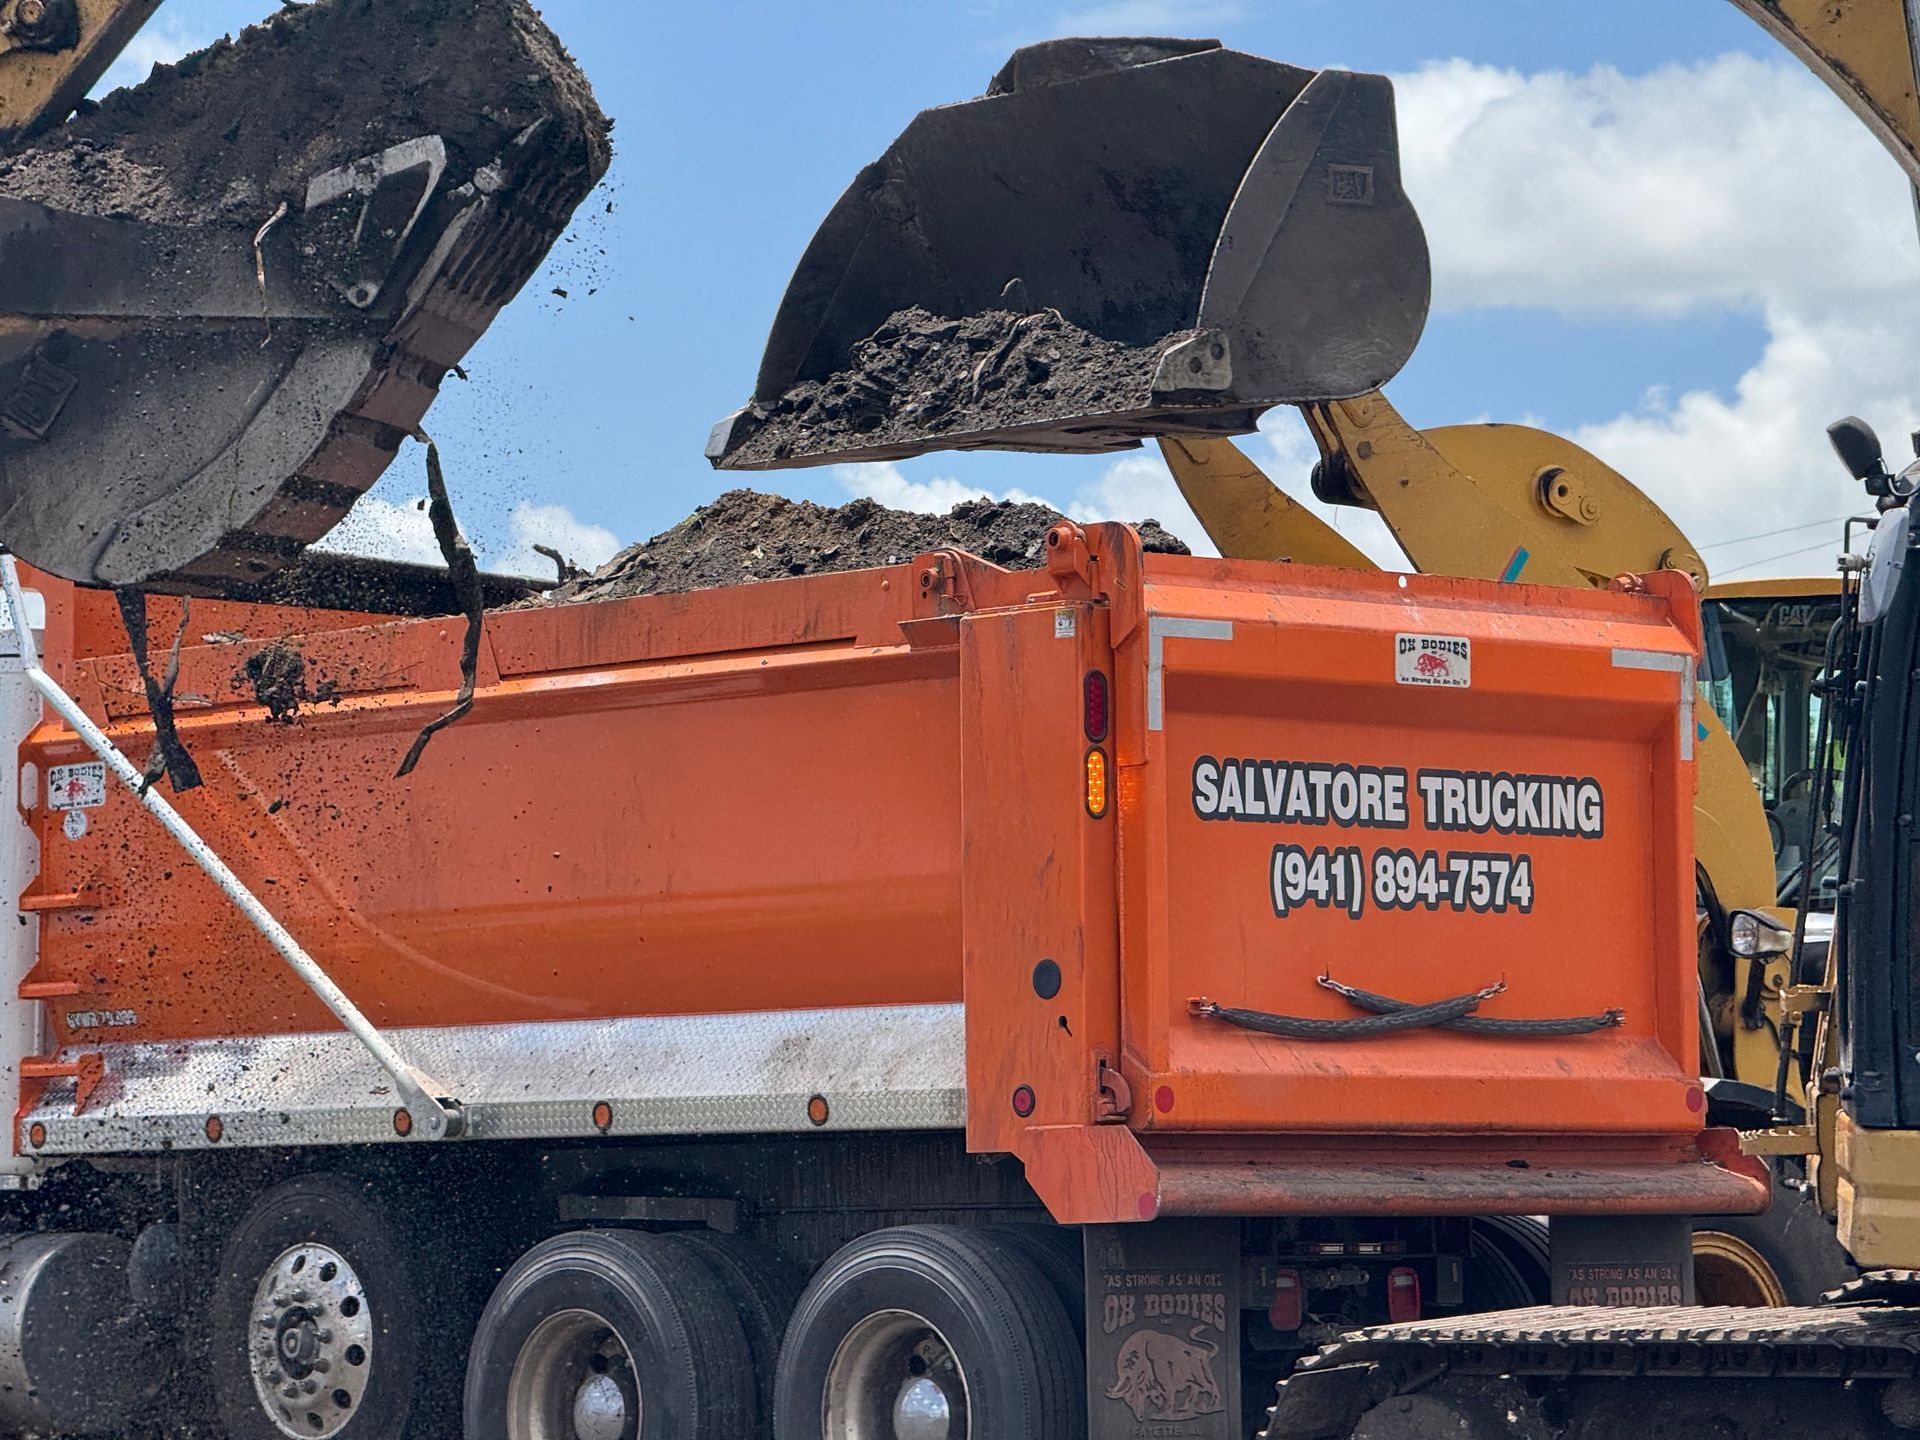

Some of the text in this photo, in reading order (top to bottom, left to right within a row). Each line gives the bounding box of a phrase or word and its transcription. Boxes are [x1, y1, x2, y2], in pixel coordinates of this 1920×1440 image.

[1778, 604, 1811, 627] CAT
[1399, 638, 1467, 660] OX BODIES
[1411, 676, 1431, 684] Strong
[68, 765, 103, 780] BODIES
[1194, 760, 1602, 835] SALVATORE TRUCKING
[1272, 848, 1532, 915] (941) 894-7574
[1125, 1274, 1164, 1288] STRONG
[1168, 1274, 1182, 1287] AS
[1187, 1274, 1201, 1287] AN
[1588, 1268, 1622, 1280] STRONG
[1627, 1268, 1640, 1280] AS
[1644, 1268, 1657, 1280] AN
[1103, 1293, 1226, 1334] OX BODIES
